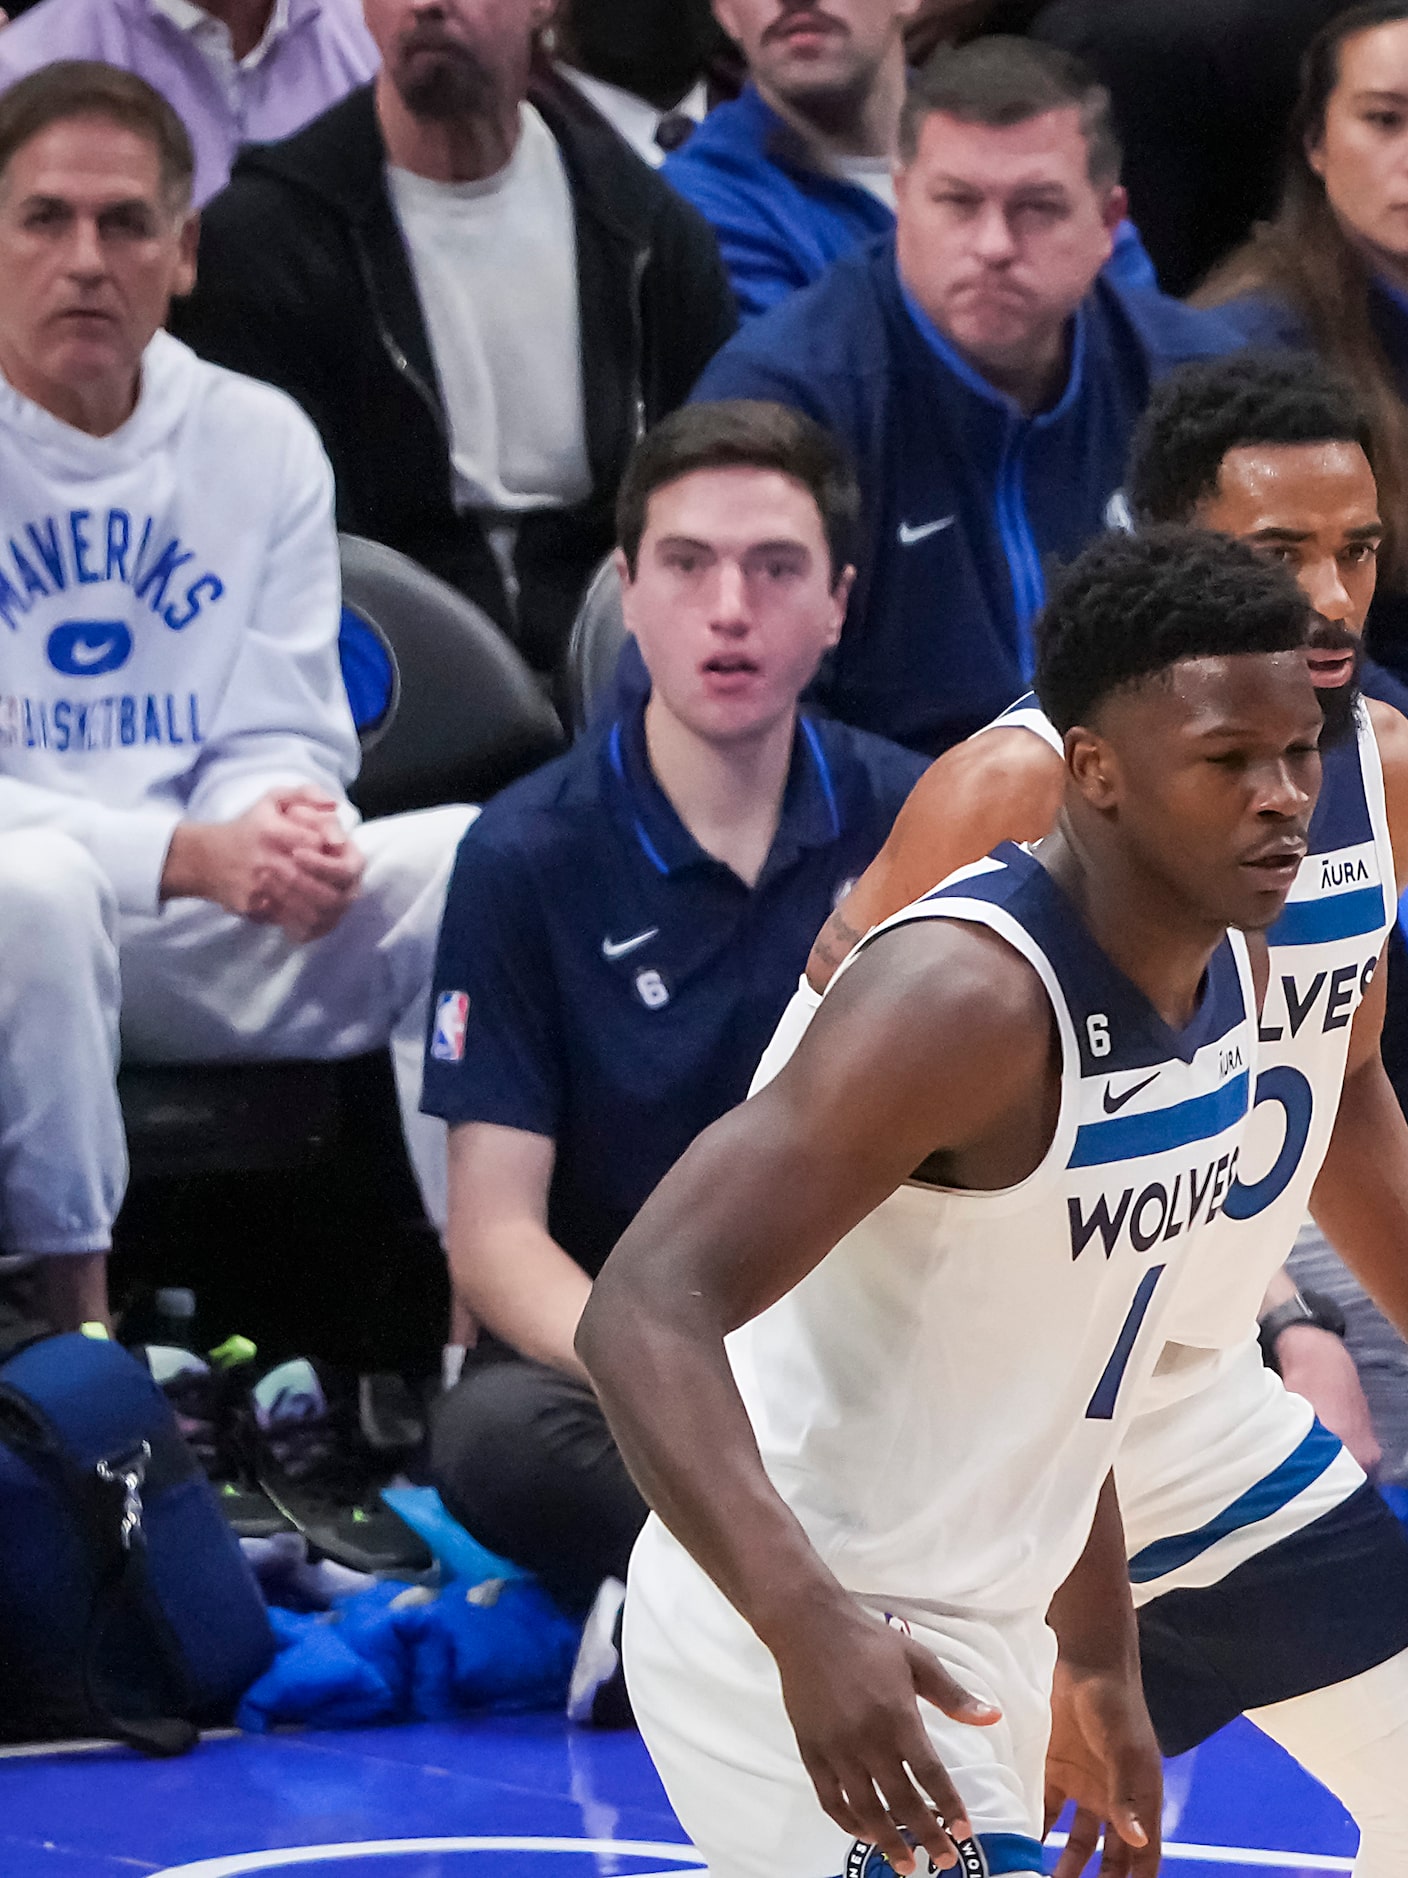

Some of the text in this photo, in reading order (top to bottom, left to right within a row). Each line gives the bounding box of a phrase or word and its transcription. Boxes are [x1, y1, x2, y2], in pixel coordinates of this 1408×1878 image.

[636, 969, 669, 1010] 6
[1086, 1013, 1111, 1058] 6
[1085, 1263, 1165, 1420] 1
